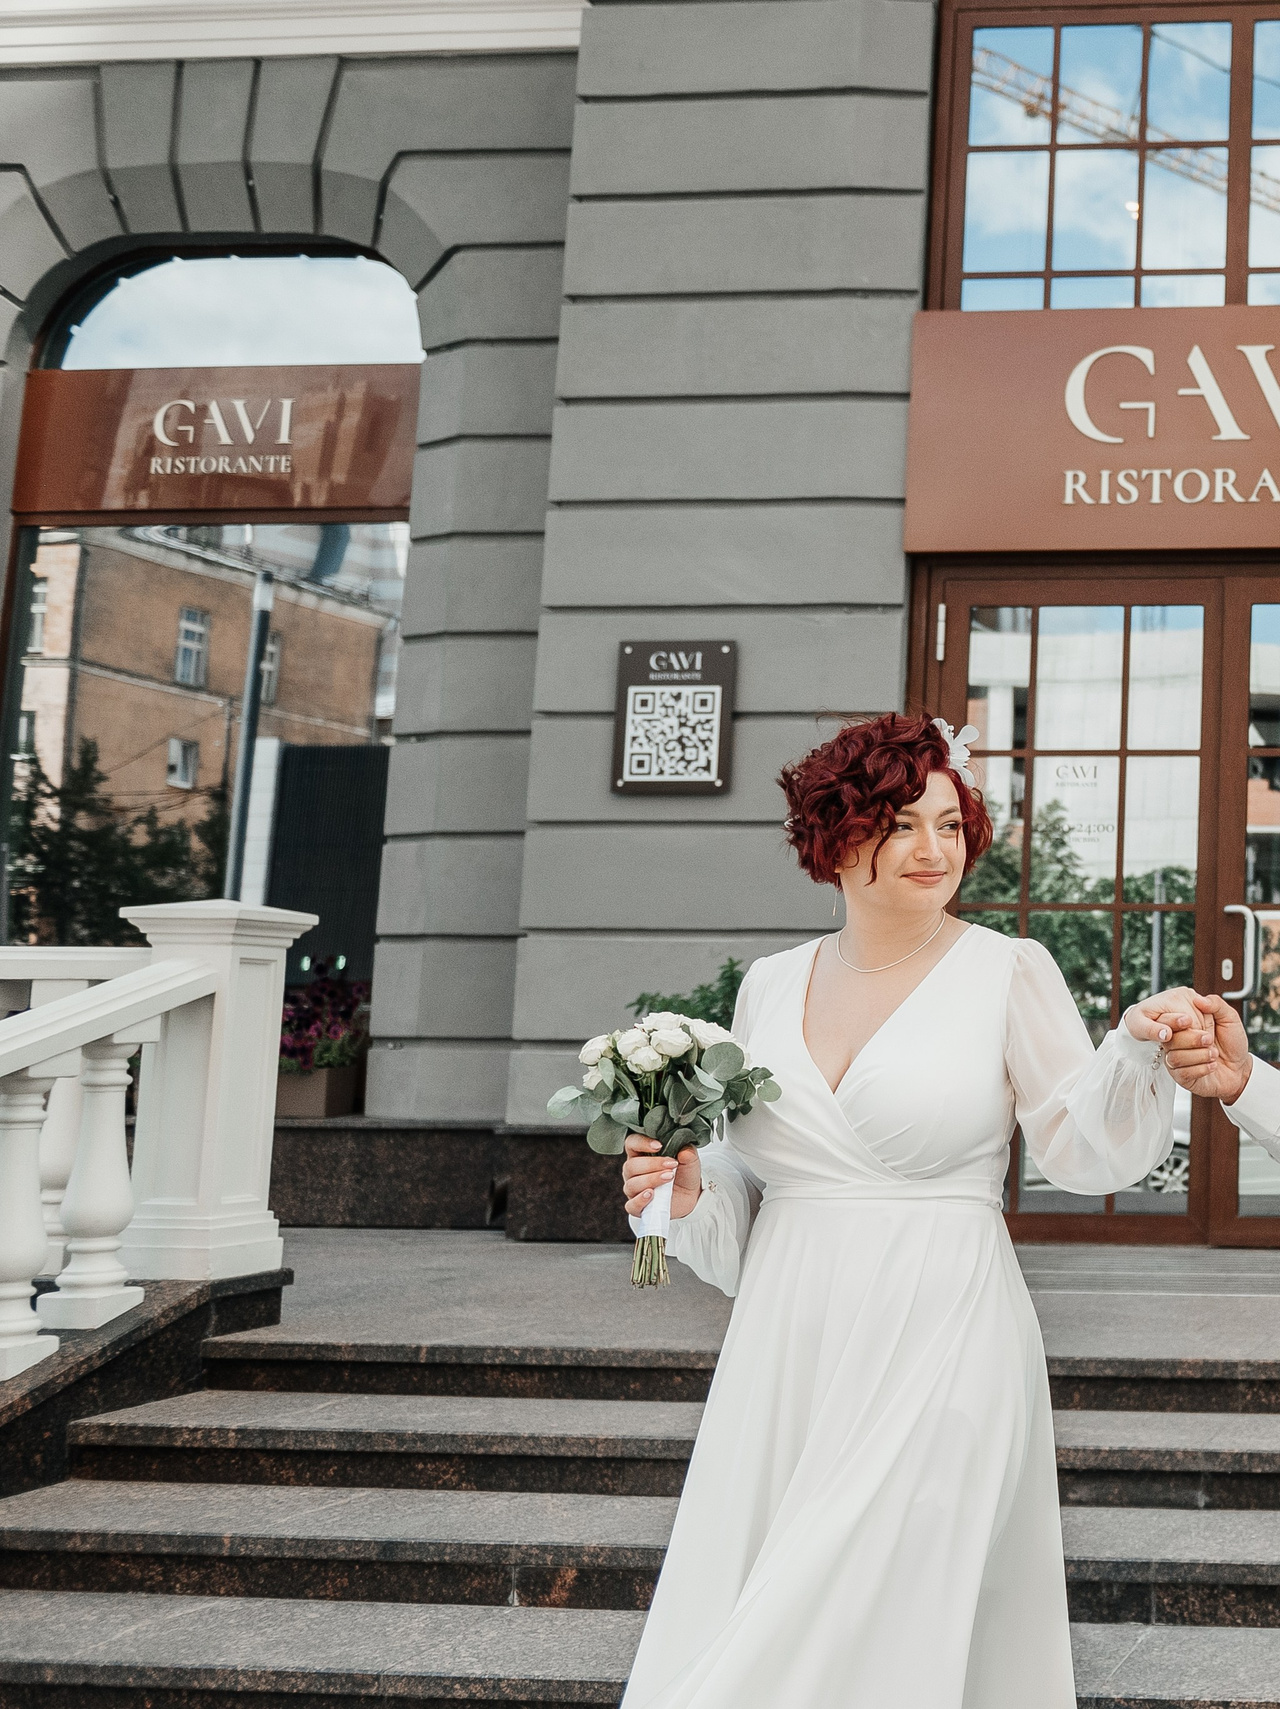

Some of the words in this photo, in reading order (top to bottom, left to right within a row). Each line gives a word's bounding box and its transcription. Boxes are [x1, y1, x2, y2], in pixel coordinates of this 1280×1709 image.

[152, 398, 297, 447] GAVI
[150, 454, 292, 475] RISTORANTE
[649, 650, 704, 671] GAVI
